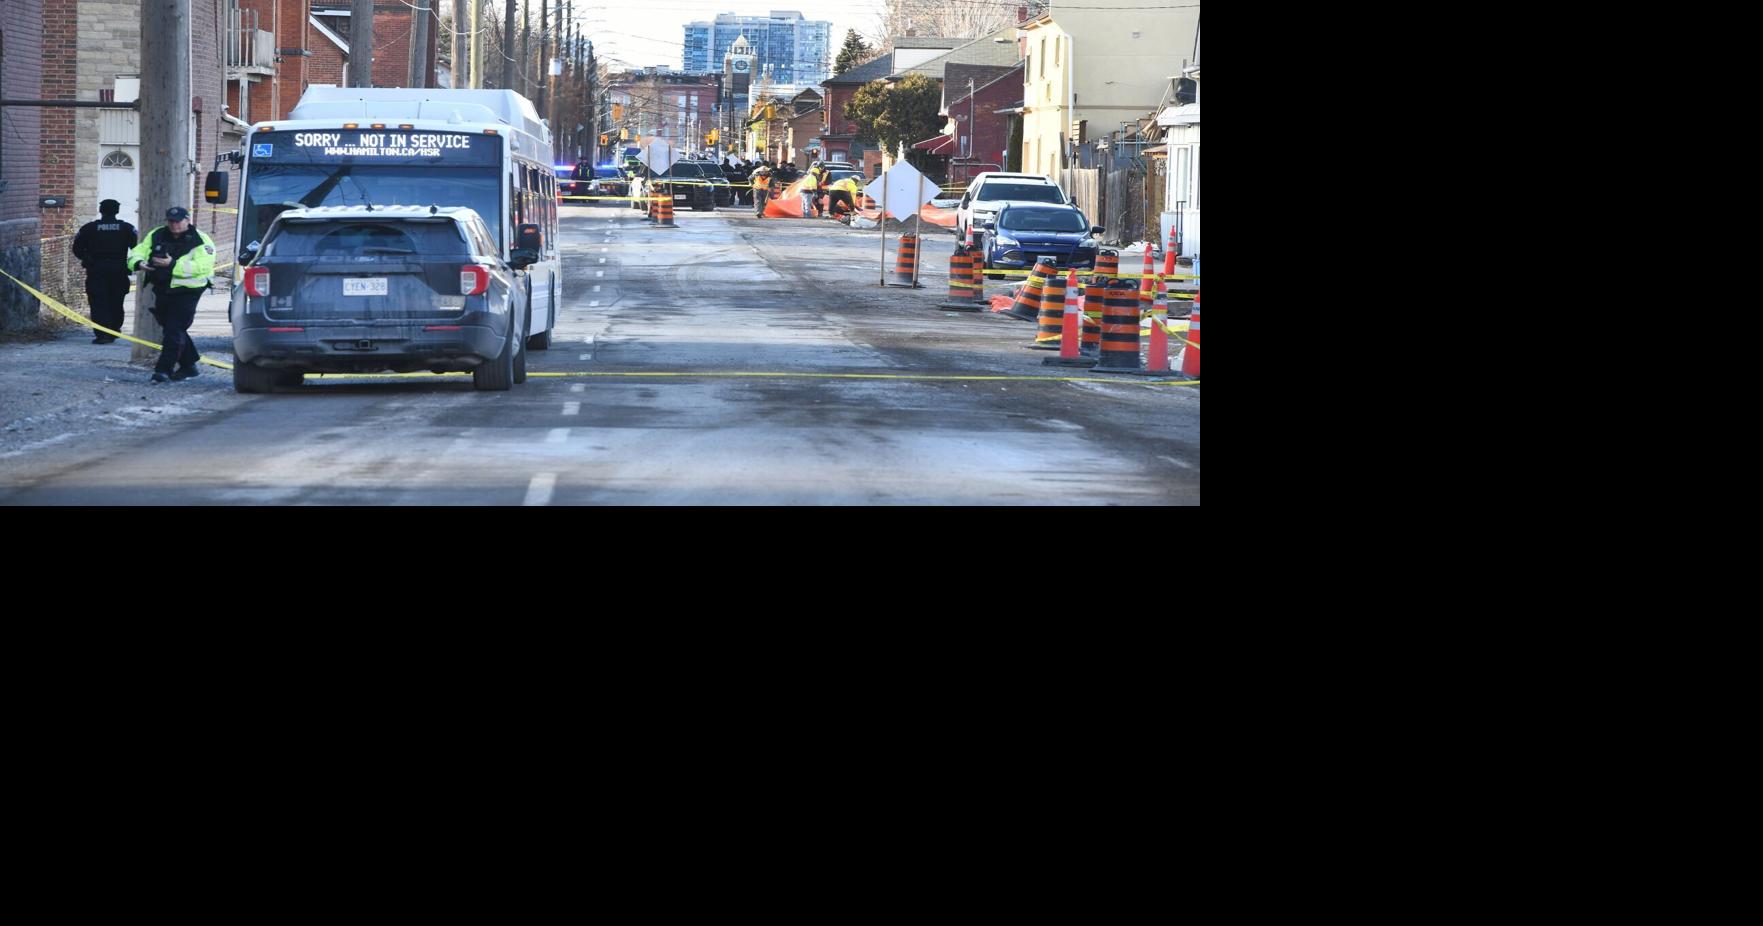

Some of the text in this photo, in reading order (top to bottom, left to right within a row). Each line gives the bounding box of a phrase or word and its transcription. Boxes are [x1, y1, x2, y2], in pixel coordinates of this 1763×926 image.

[295, 133, 341, 147] SORRY
[360, 134, 385, 147] NOT
[390, 134, 407, 148] IN
[411, 134, 471, 149] SERVICE
[324, 147, 440, 157] WWW.HAMILTON.CA/HSR
[97, 223, 120, 231] POLICE
